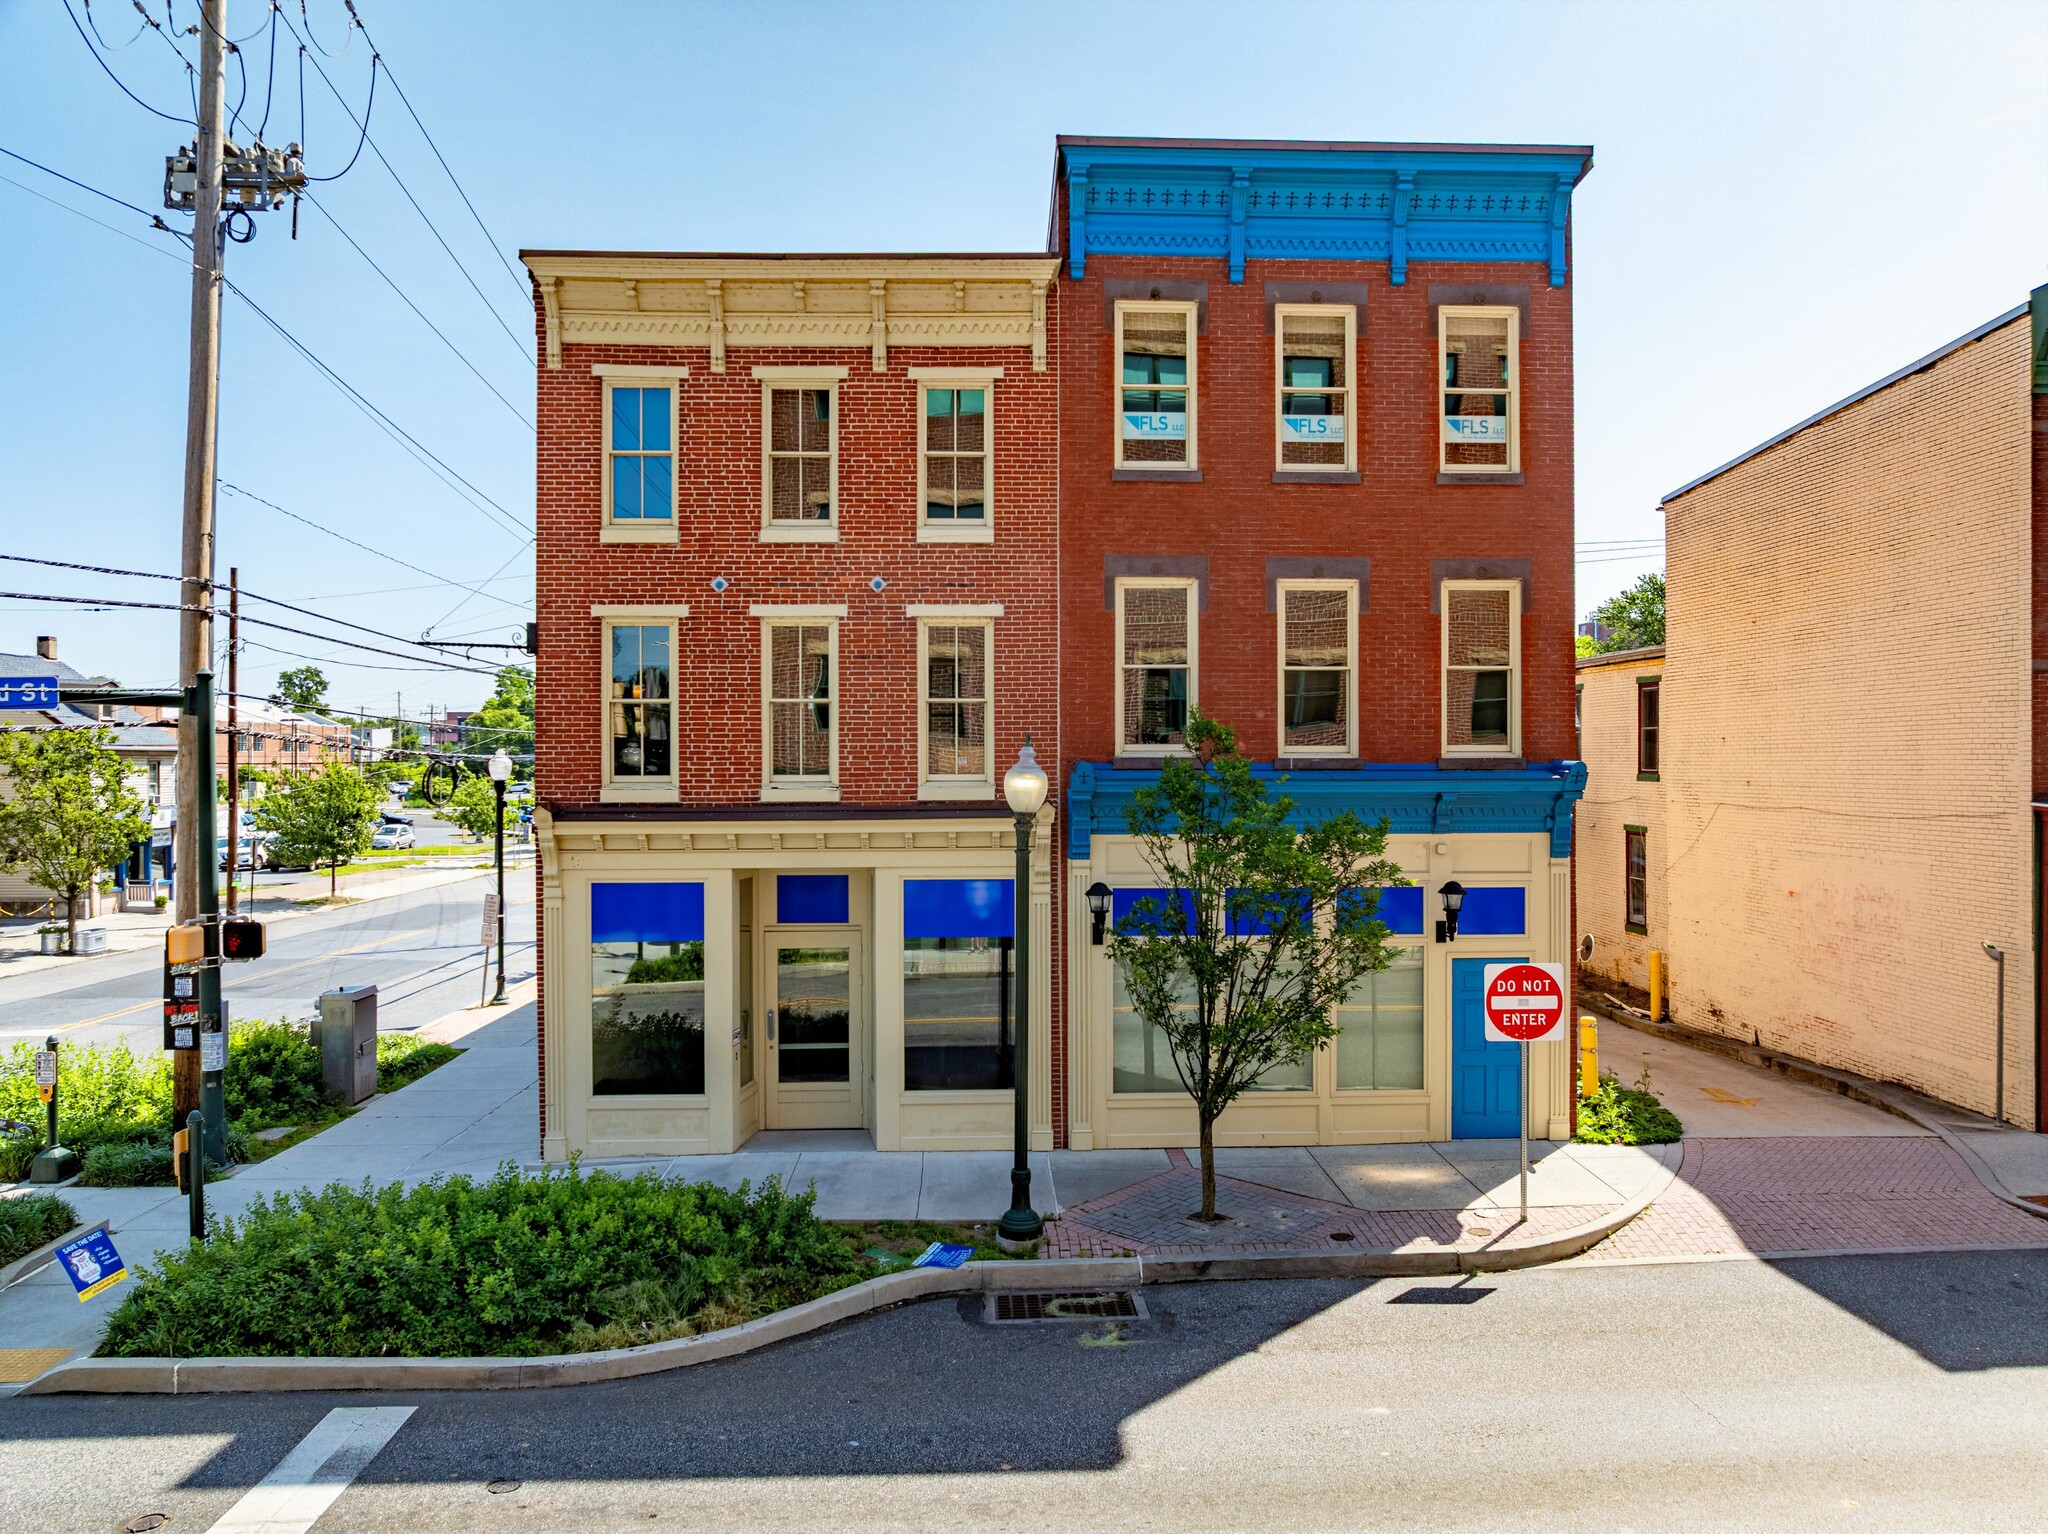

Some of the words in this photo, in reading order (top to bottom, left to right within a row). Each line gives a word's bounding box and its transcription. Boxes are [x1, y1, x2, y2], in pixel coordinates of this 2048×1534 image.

[1139, 415, 1169, 431] FLS
[1298, 418, 1327, 434] FLS
[1461, 419, 1489, 434] FLS
[21, 682, 48, 701] St
[1497, 980, 1516, 992] DO
[1523, 979, 1551, 992] NOT
[165, 1005, 177, 1015] WE
[180, 1003, 199, 1013] FIGH
[170, 1011, 199, 1023] BACK!
[1503, 1013, 1546, 1026] ENTER
[62, 1243, 79, 1255] SAVE
[77, 1237, 89, 1247] THE
[87, 1230, 103, 1242] DATE!
